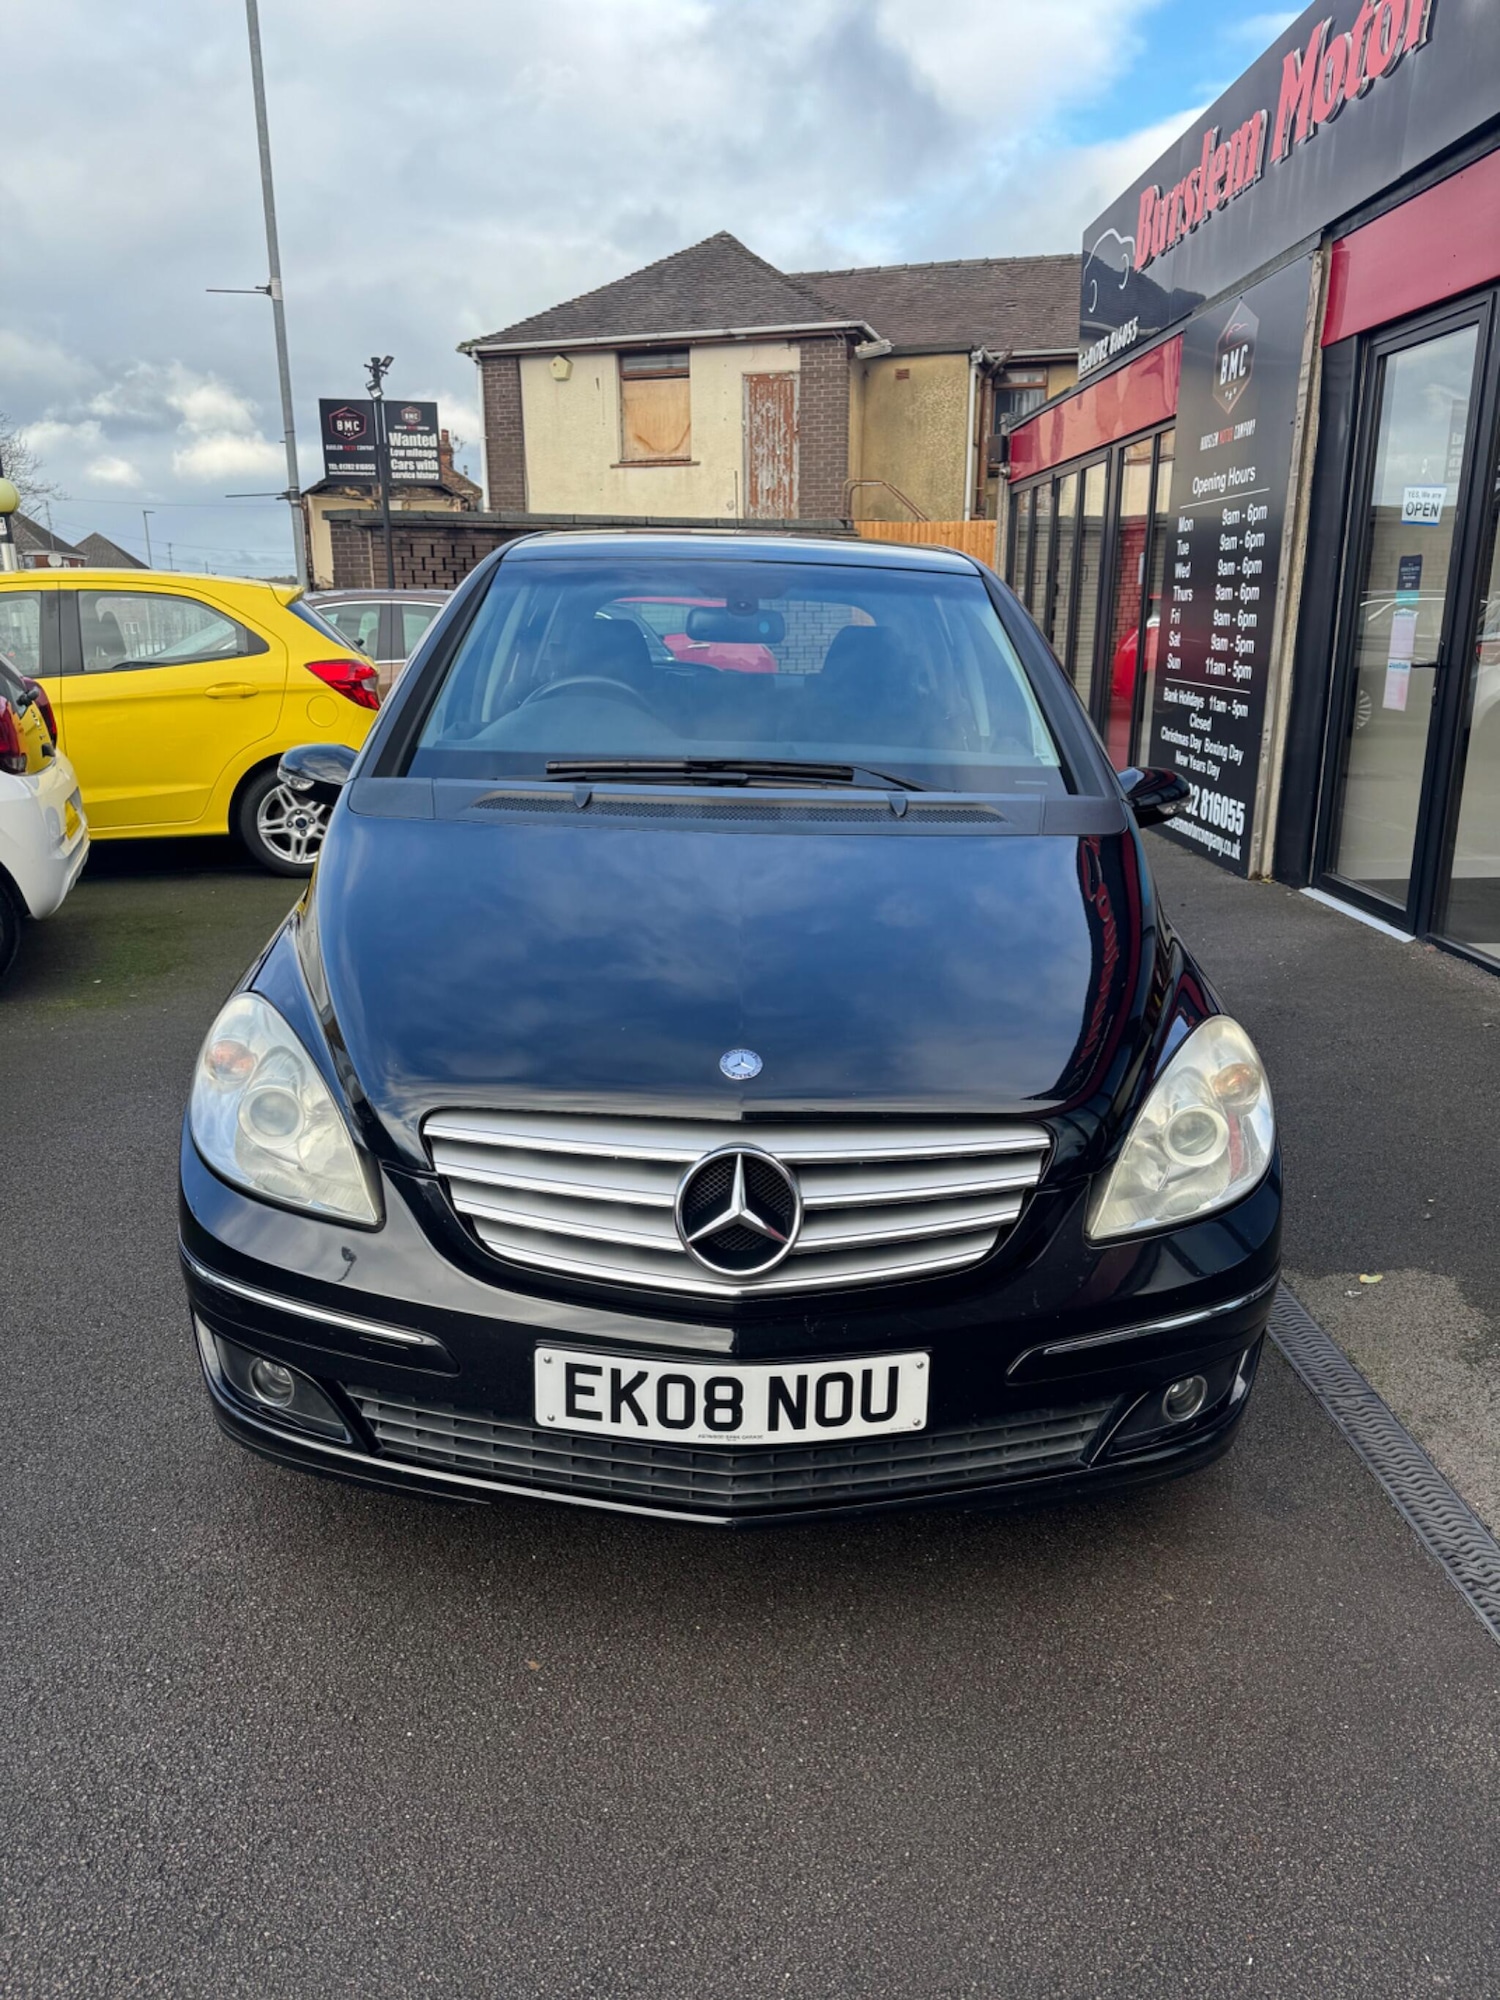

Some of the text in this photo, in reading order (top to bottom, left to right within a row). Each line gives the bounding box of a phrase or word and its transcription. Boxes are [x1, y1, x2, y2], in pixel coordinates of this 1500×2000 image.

[1134, 109, 1267, 272] Burslem
[1220, 344, 1248, 385] BMC
[336, 420, 360, 431] BMC
[388, 432, 438, 447] Wanted
[390, 447, 438, 459] Low mileage
[390, 458, 439, 470] Cars with
[391, 471, 416, 479] service
[1192, 466, 1256, 498] Opening Hours
[1222, 508, 1240, 526] 9am
[1247, 503, 1268, 526] 6pm
[1405, 501, 1440, 517] OPEN
[1177, 516, 1194, 533] Mon
[1177, 540, 1189, 556] Tue
[1219, 533, 1237, 551] 9am
[1244, 530, 1265, 553] 6pm
[1174, 562, 1191, 579] Wed
[1217, 559, 1235, 577] 9am
[1242, 556, 1262, 578] 6pm
[1173, 586, 1193, 602] Thurs
[1215, 584, 1233, 601] 9am
[1240, 582, 1260, 604] 6pm
[1170, 608, 1181, 624] Fri
[1213, 609, 1230, 626] 9am
[1237, 609, 1257, 631] 6pm
[1168, 631, 1181, 648] Sat
[1210, 633, 1228, 651] 9am
[1234, 635, 1255, 657] 5pm
[1167, 653, 1181, 670] Sun
[1205, 657, 1226, 676] 11am
[1232, 657, 1253, 682] 5pm
[1163, 687, 1179, 703] Bank
[1179, 689, 1205, 711] Holidays
[1209, 695, 1227, 713] 11am
[1231, 699, 1249, 719] 5pm
[1189, 712, 1212, 732] Closed
[1161, 726, 1244, 766] Christmas Day Boxing Day
[1175, 750, 1220, 781] New Years Day
[1200, 788, 1246, 836] 816055
[565, 1361, 899, 1432] EK08 NOU
